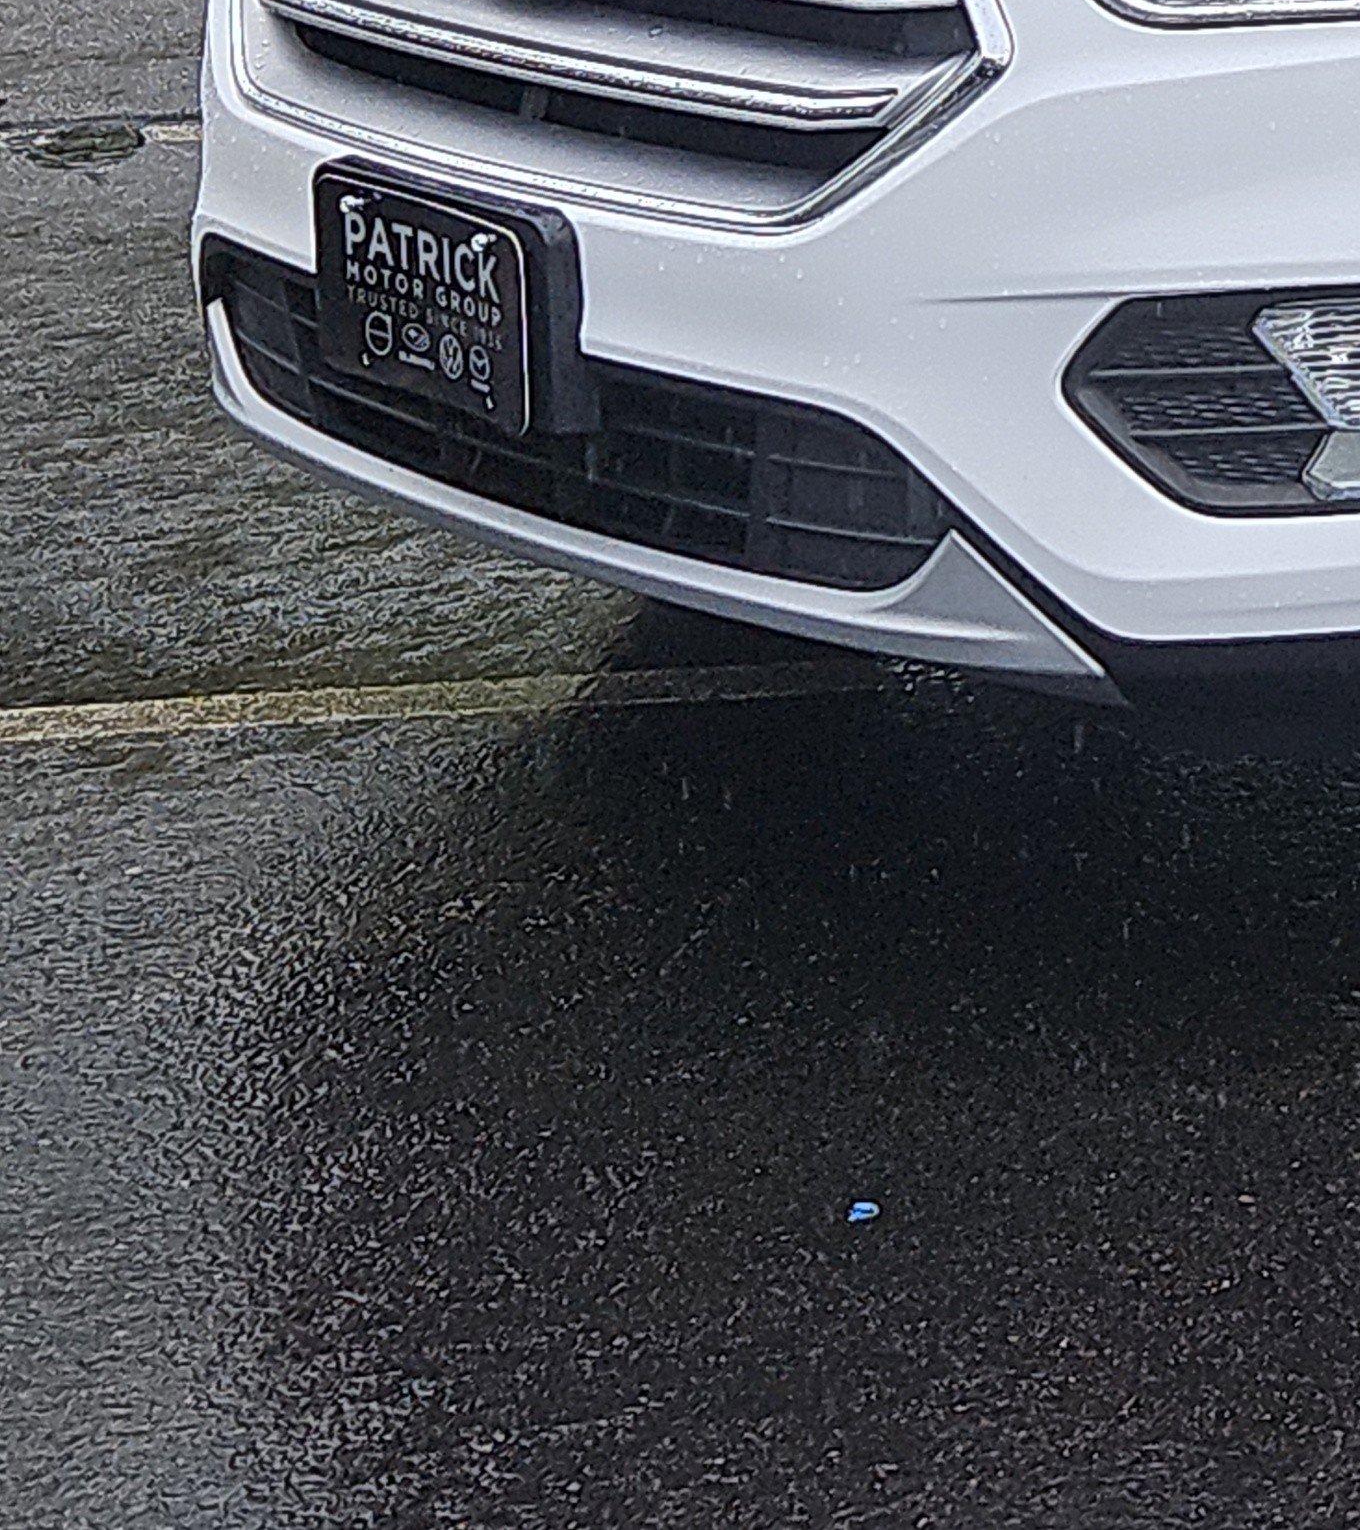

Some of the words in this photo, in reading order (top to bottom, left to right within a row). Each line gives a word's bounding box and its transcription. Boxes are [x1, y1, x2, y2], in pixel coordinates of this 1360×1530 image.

[344, 211, 500, 303] PATRICK
[345, 259, 424, 299] MOTOR
[435, 285, 502, 326] GROUP
[346, 285, 419, 319] TRUSTED
